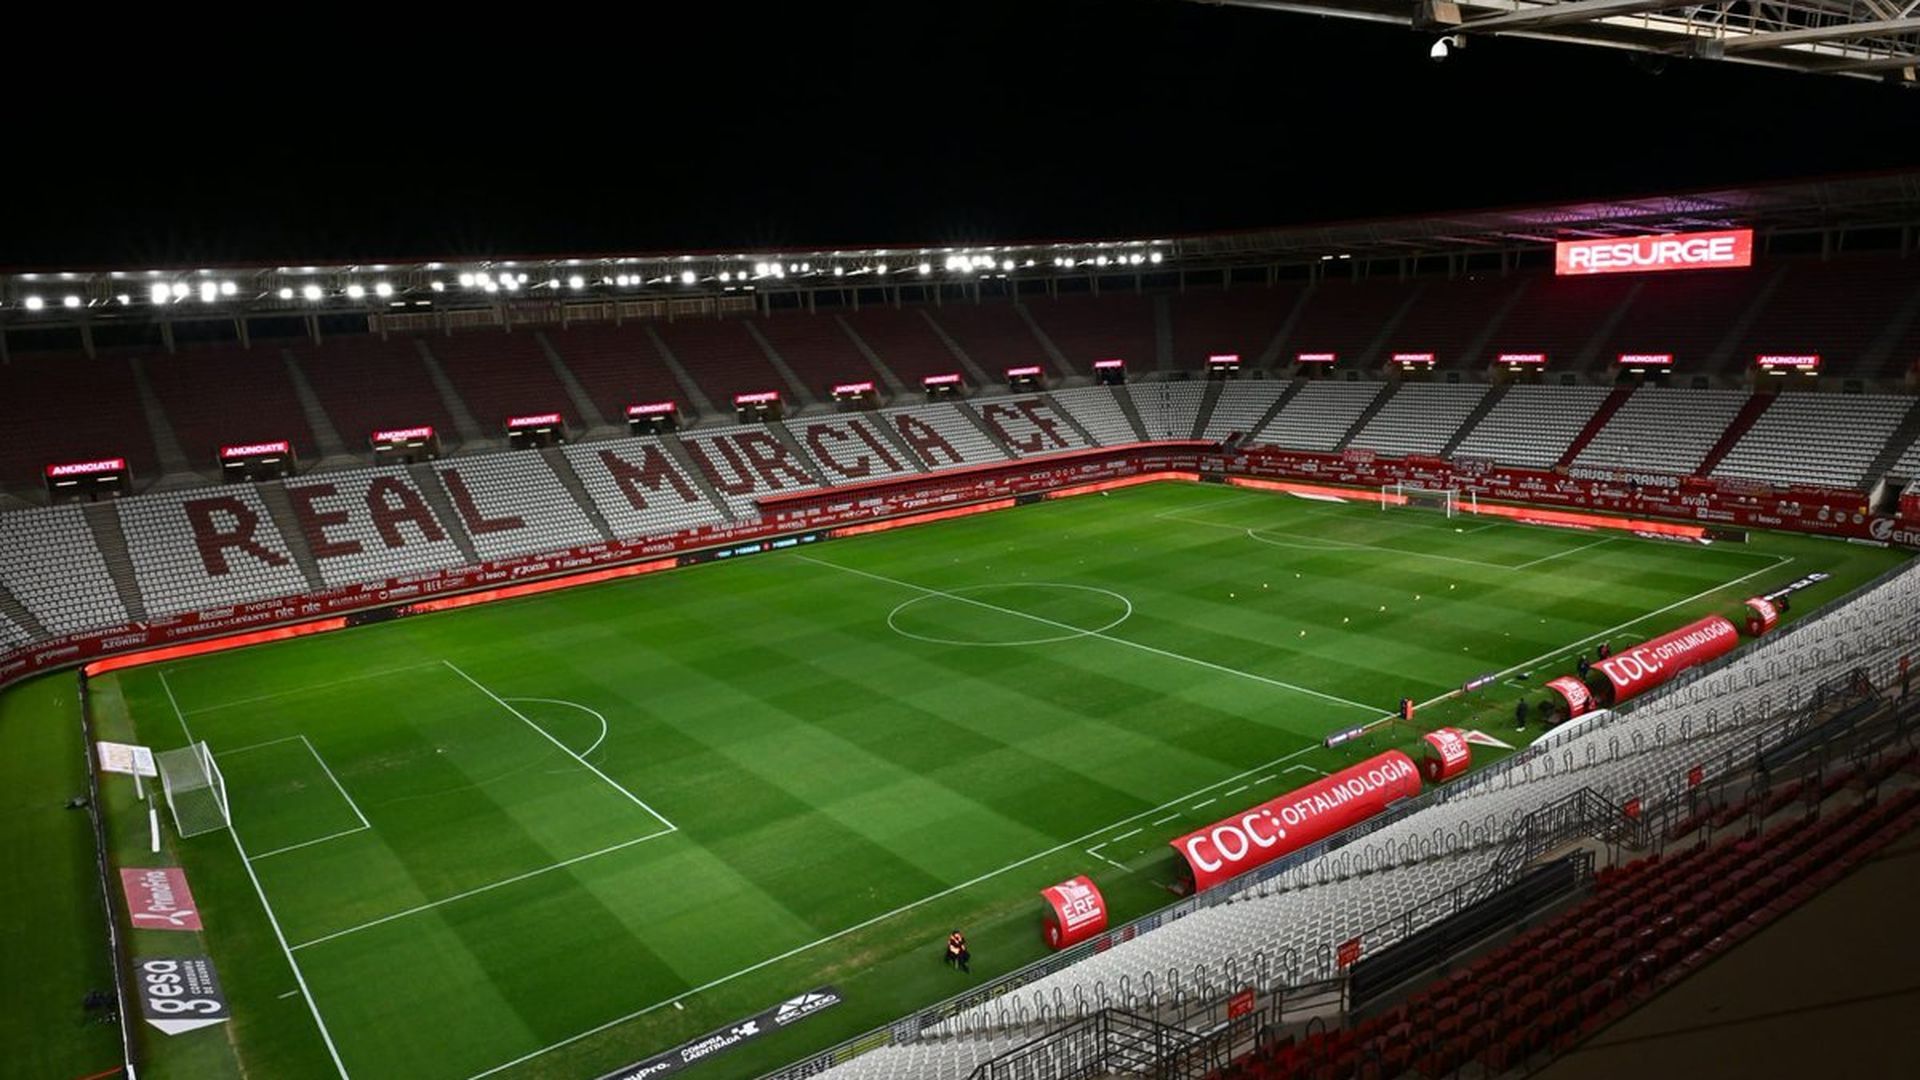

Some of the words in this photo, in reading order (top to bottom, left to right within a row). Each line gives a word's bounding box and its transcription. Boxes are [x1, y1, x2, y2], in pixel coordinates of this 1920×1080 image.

[1569, 237, 1736, 268] RESURGE
[187, 469, 527, 576] REAL
[600, 413, 965, 509] MURCIA
[982, 400, 1072, 453] CF
[1062, 894, 1097, 918] ERF
[143, 960, 222, 1014] gesa
[681, 1034, 725, 1057] COMPRA
